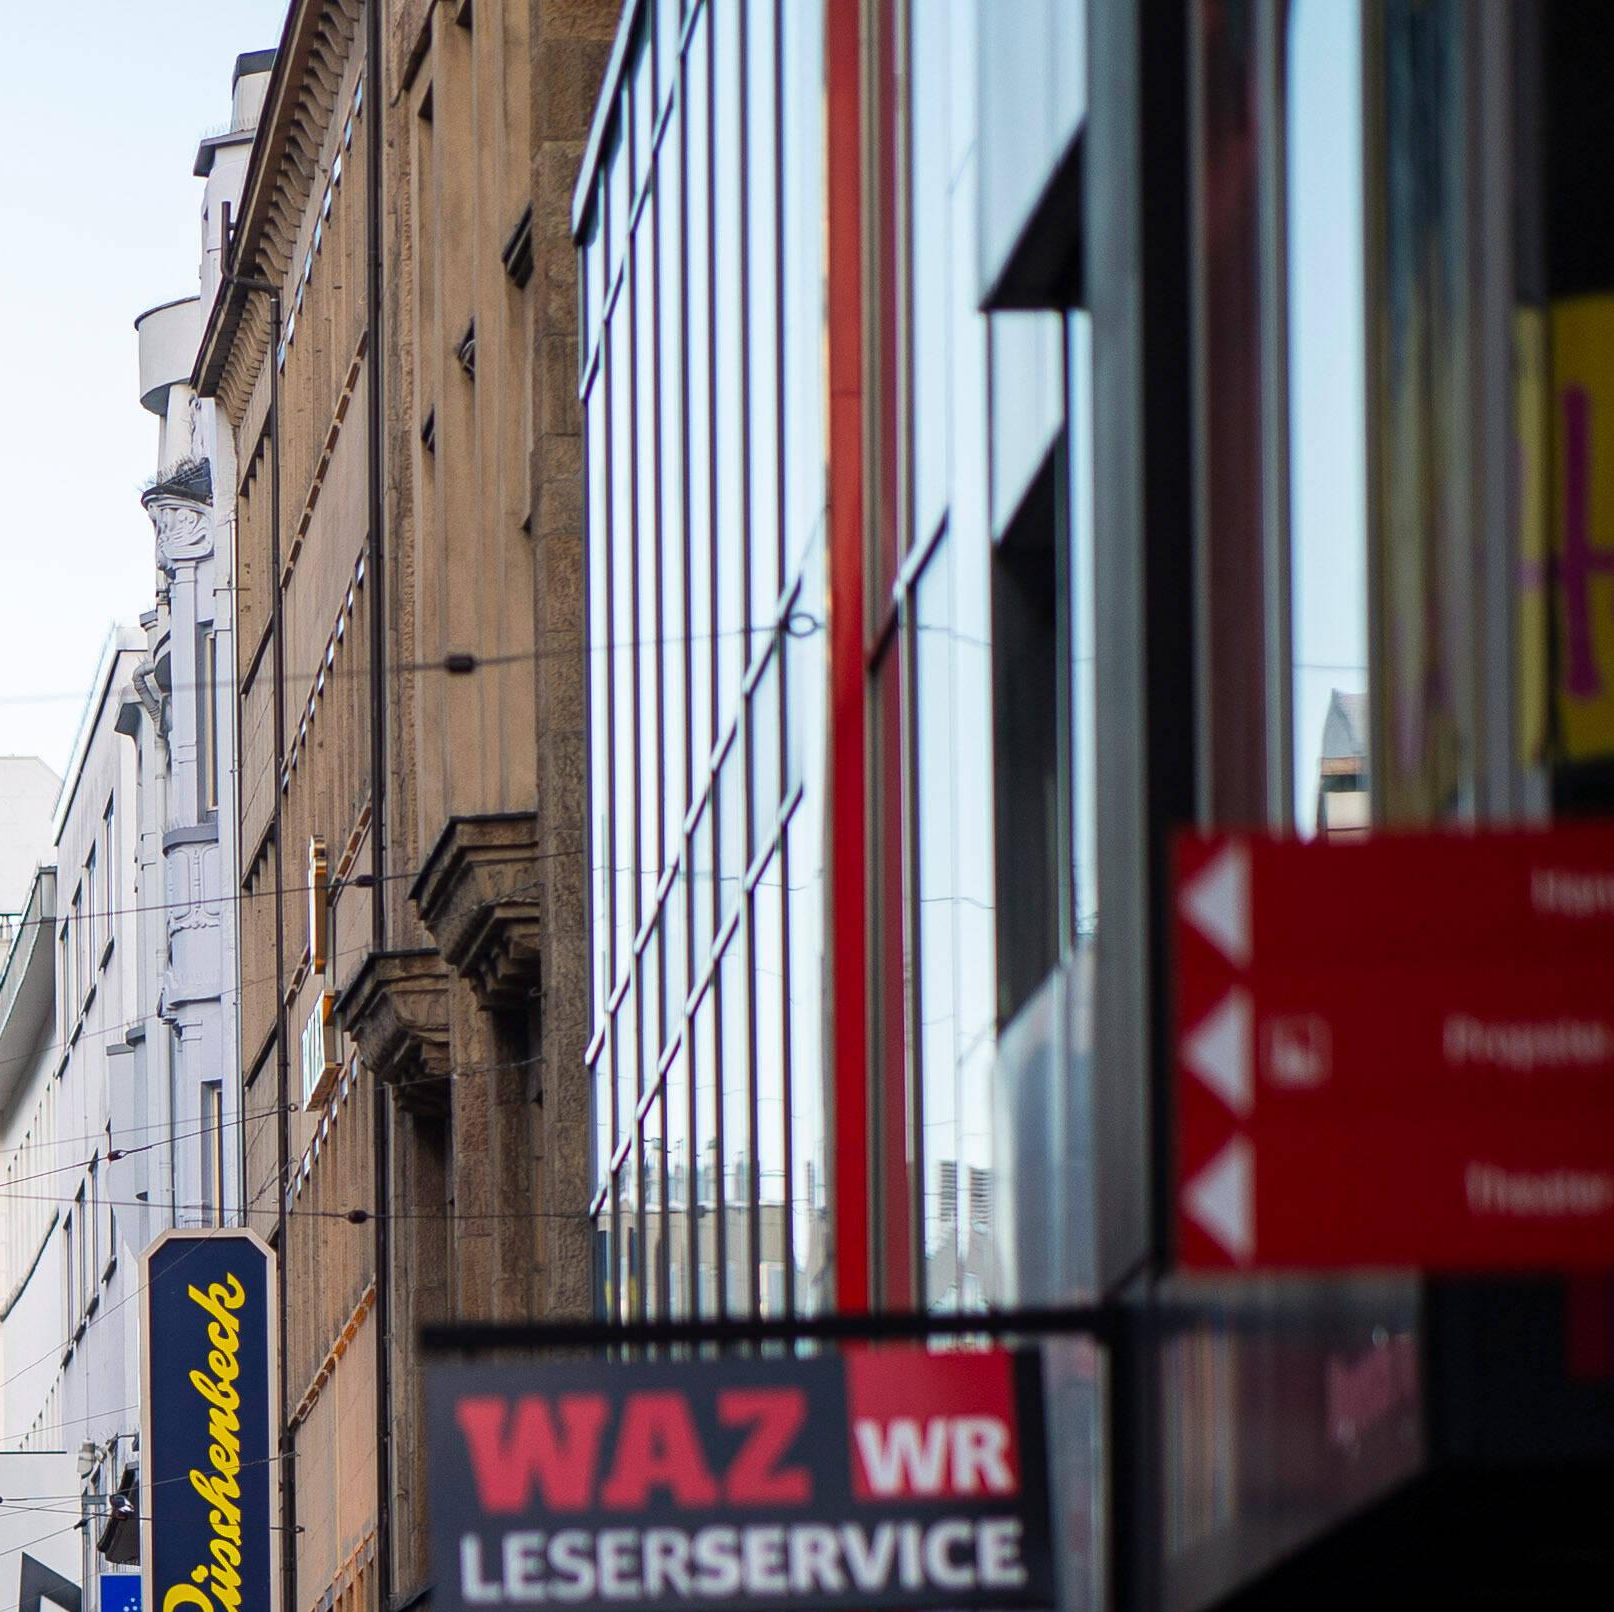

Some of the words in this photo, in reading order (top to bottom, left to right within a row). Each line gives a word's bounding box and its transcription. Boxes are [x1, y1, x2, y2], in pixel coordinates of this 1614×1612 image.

[455, 1388, 813, 1513] WAZ
[855, 1415, 1017, 1498] WR
[459, 1517, 1028, 1604] LESERSERVICE
